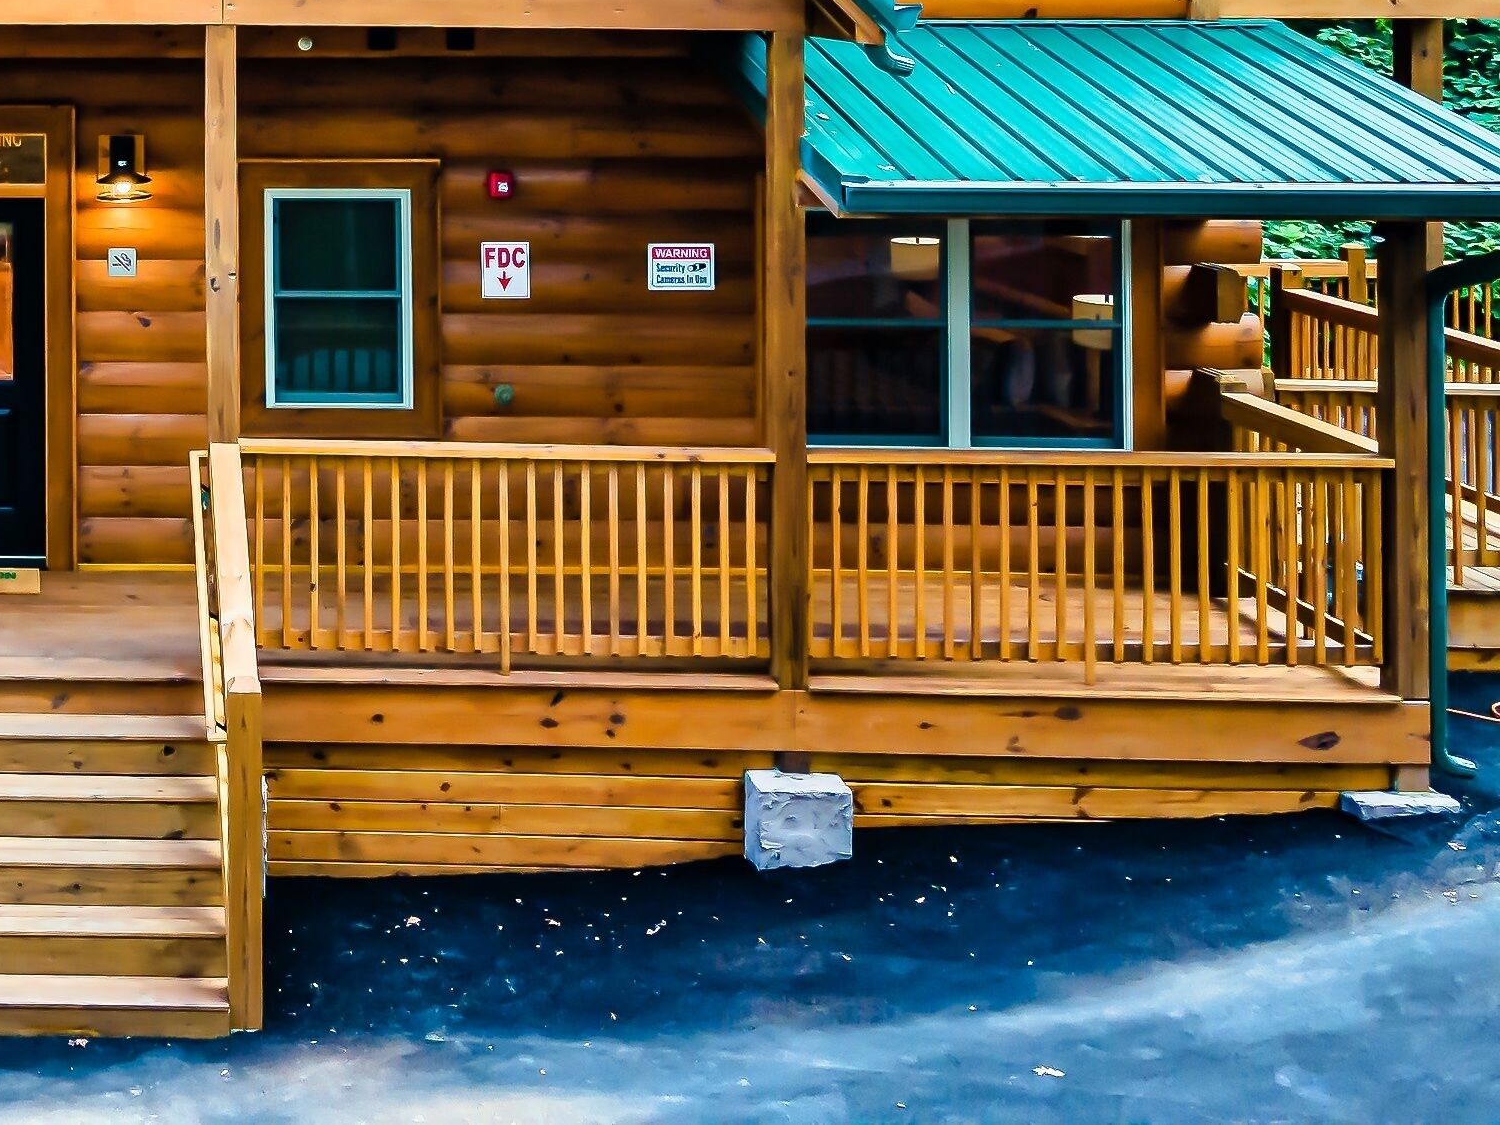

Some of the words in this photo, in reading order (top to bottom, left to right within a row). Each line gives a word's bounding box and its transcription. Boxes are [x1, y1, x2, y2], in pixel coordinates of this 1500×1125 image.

[484, 247, 526, 268] FDC
[655, 248, 708, 259] WARNING
[655, 262, 686, 274] Security
[656, 274, 685, 284] Cameras
